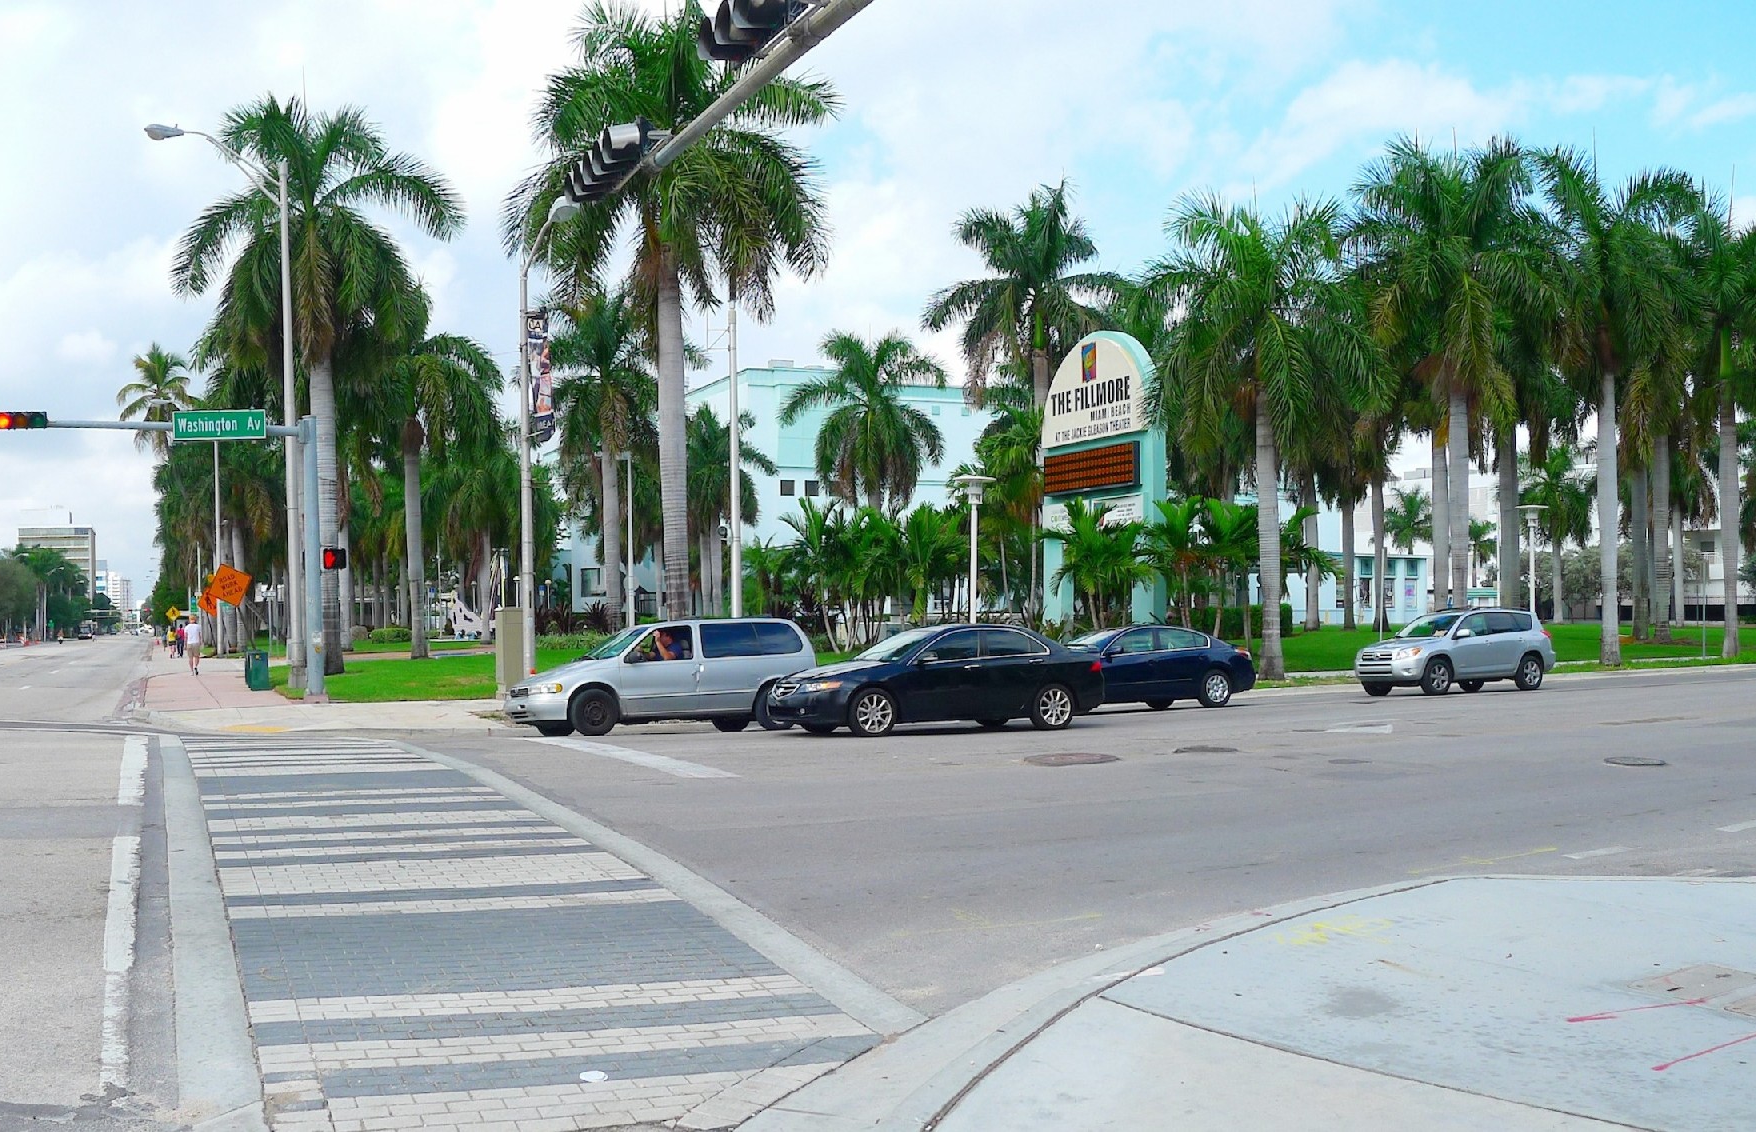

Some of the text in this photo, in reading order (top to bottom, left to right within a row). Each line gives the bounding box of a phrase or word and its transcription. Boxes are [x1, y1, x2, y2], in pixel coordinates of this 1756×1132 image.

[1051, 375, 1131, 416] THE FILLMORE
[1090, 402, 1131, 421] MIAMI BEACH
[177, 416, 261, 436] Washington Av
[1071, 426, 1087, 440] JACKIE
[1087, 421, 1109, 437] GLEASON
[1109, 417, 1131, 433] THEATER
[219, 574, 235, 585] ROAD
[221, 580, 239, 591] WORK
[222, 586, 243, 598] AHEAD
